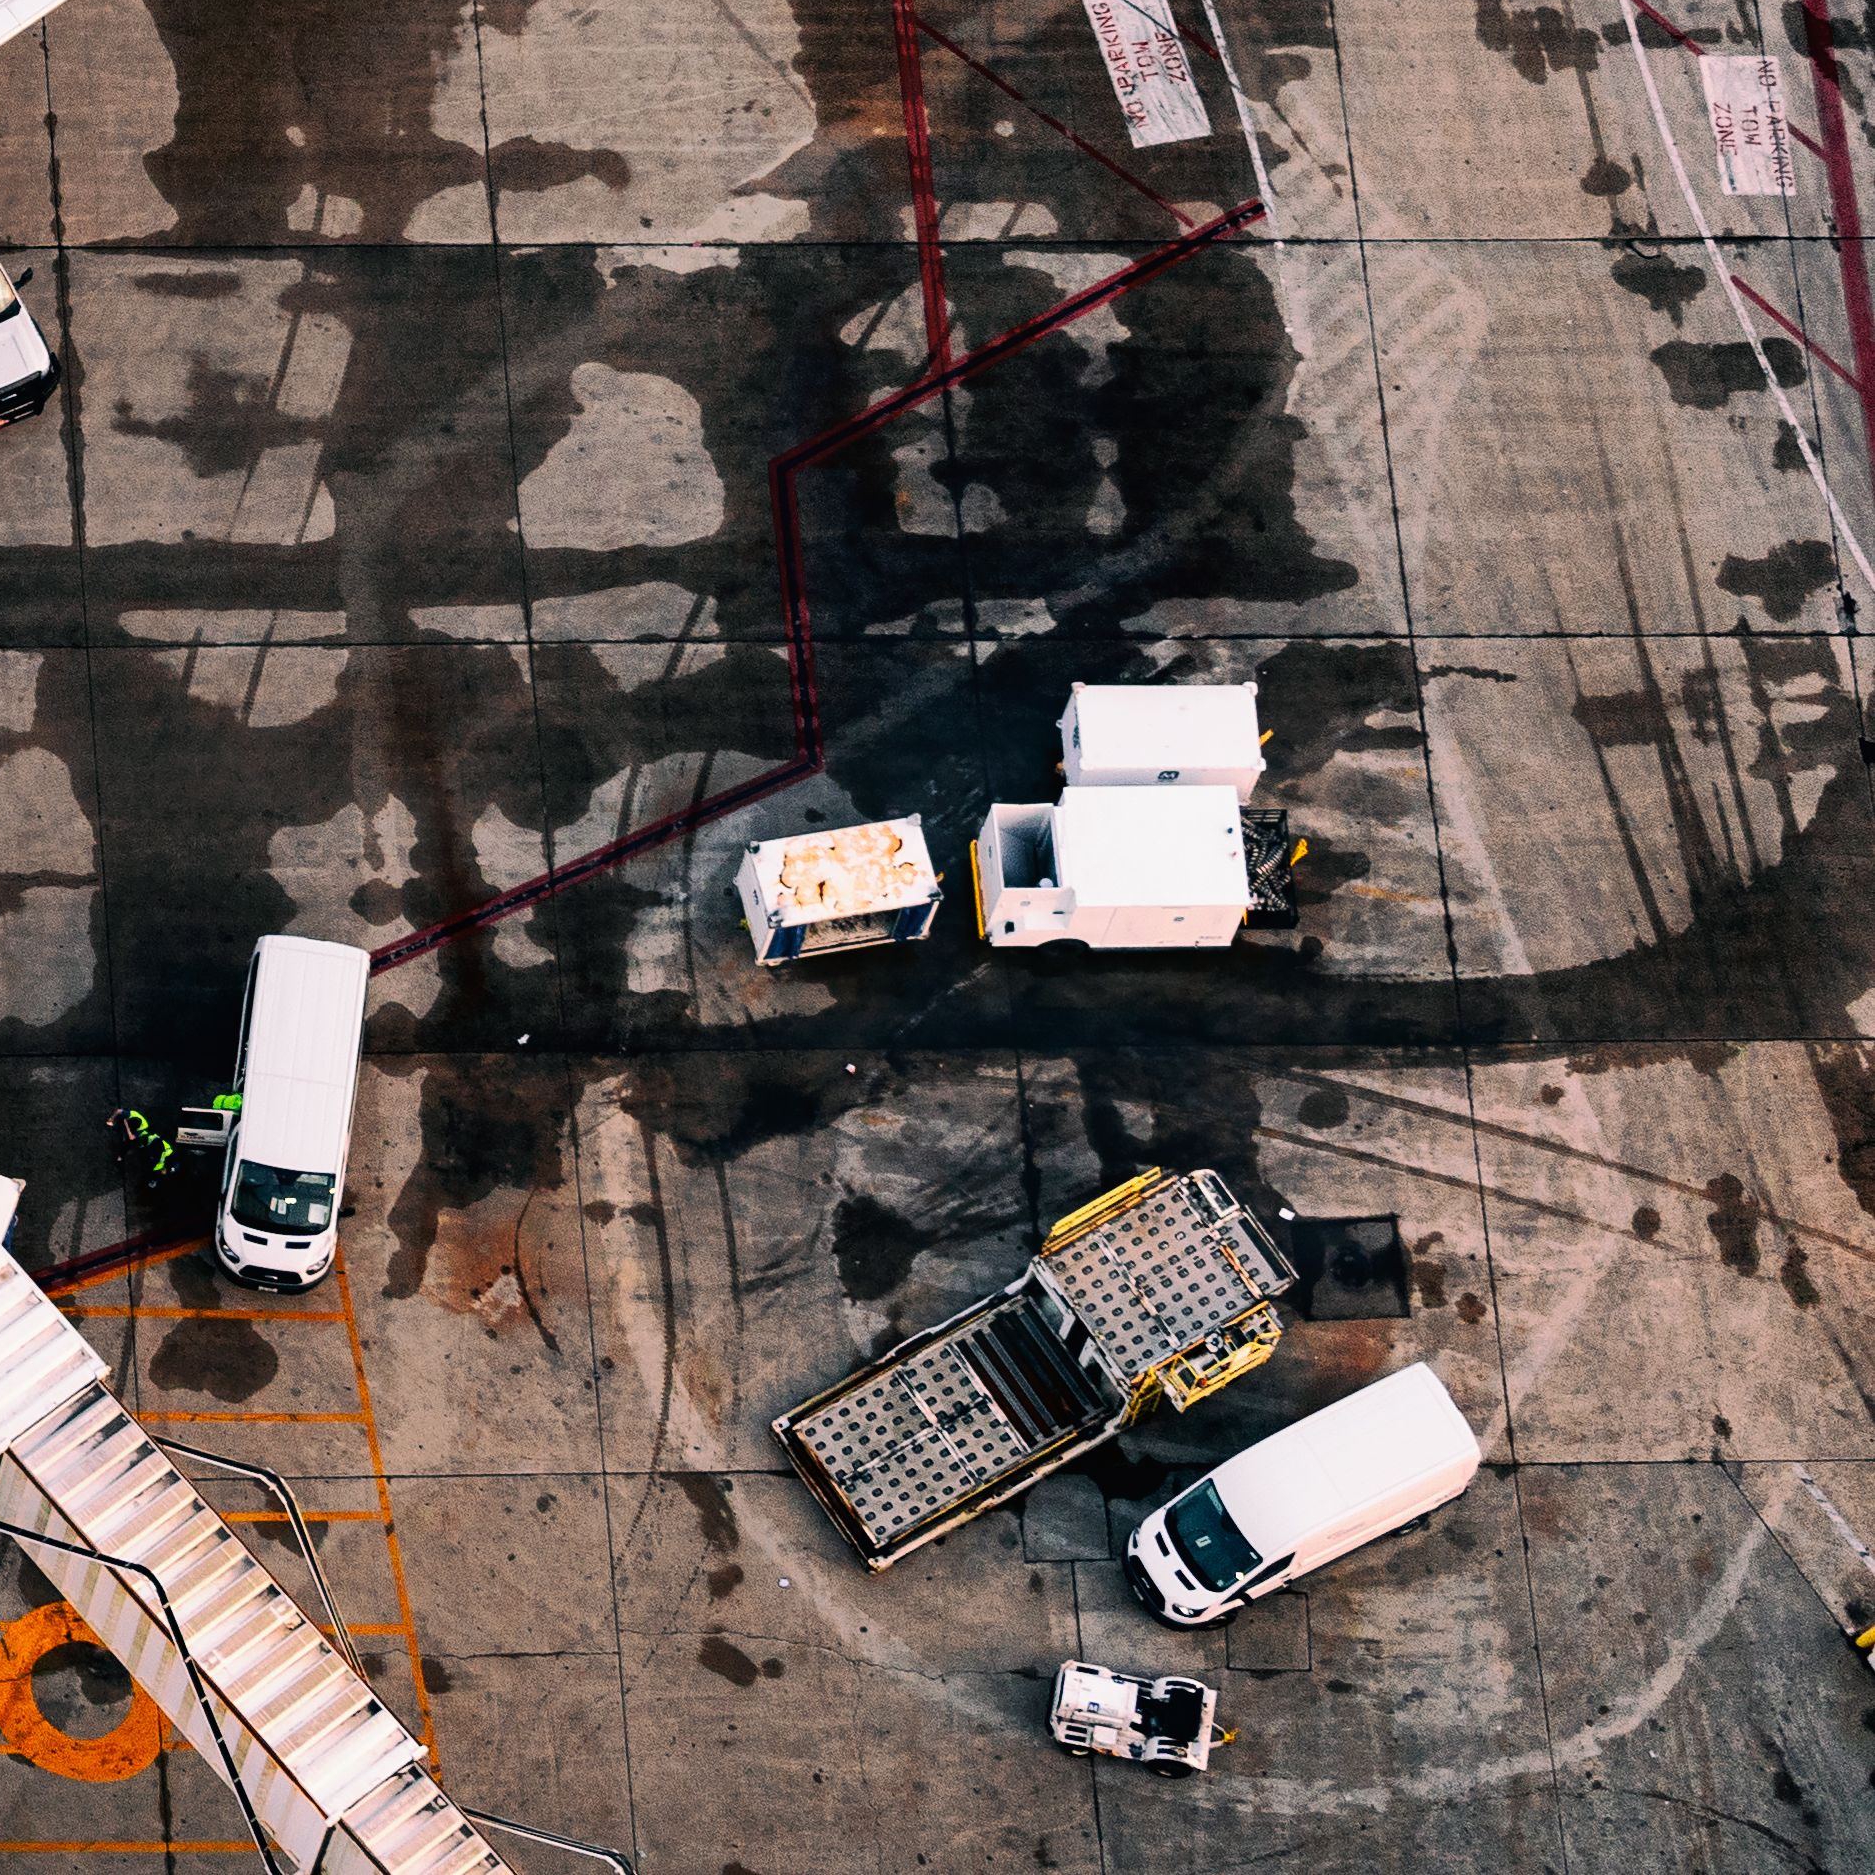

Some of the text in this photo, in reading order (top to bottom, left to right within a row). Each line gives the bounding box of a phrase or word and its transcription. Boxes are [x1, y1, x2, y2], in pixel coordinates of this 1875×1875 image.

[1092, 2, 1148, 128] NO PARKING
[1132, 41, 1158, 83] TOW
[1714, 102, 1738, 155] ZONE
[1740, 106, 1761, 145] TOW
[1757, 60, 1793, 188] NO PARKING
